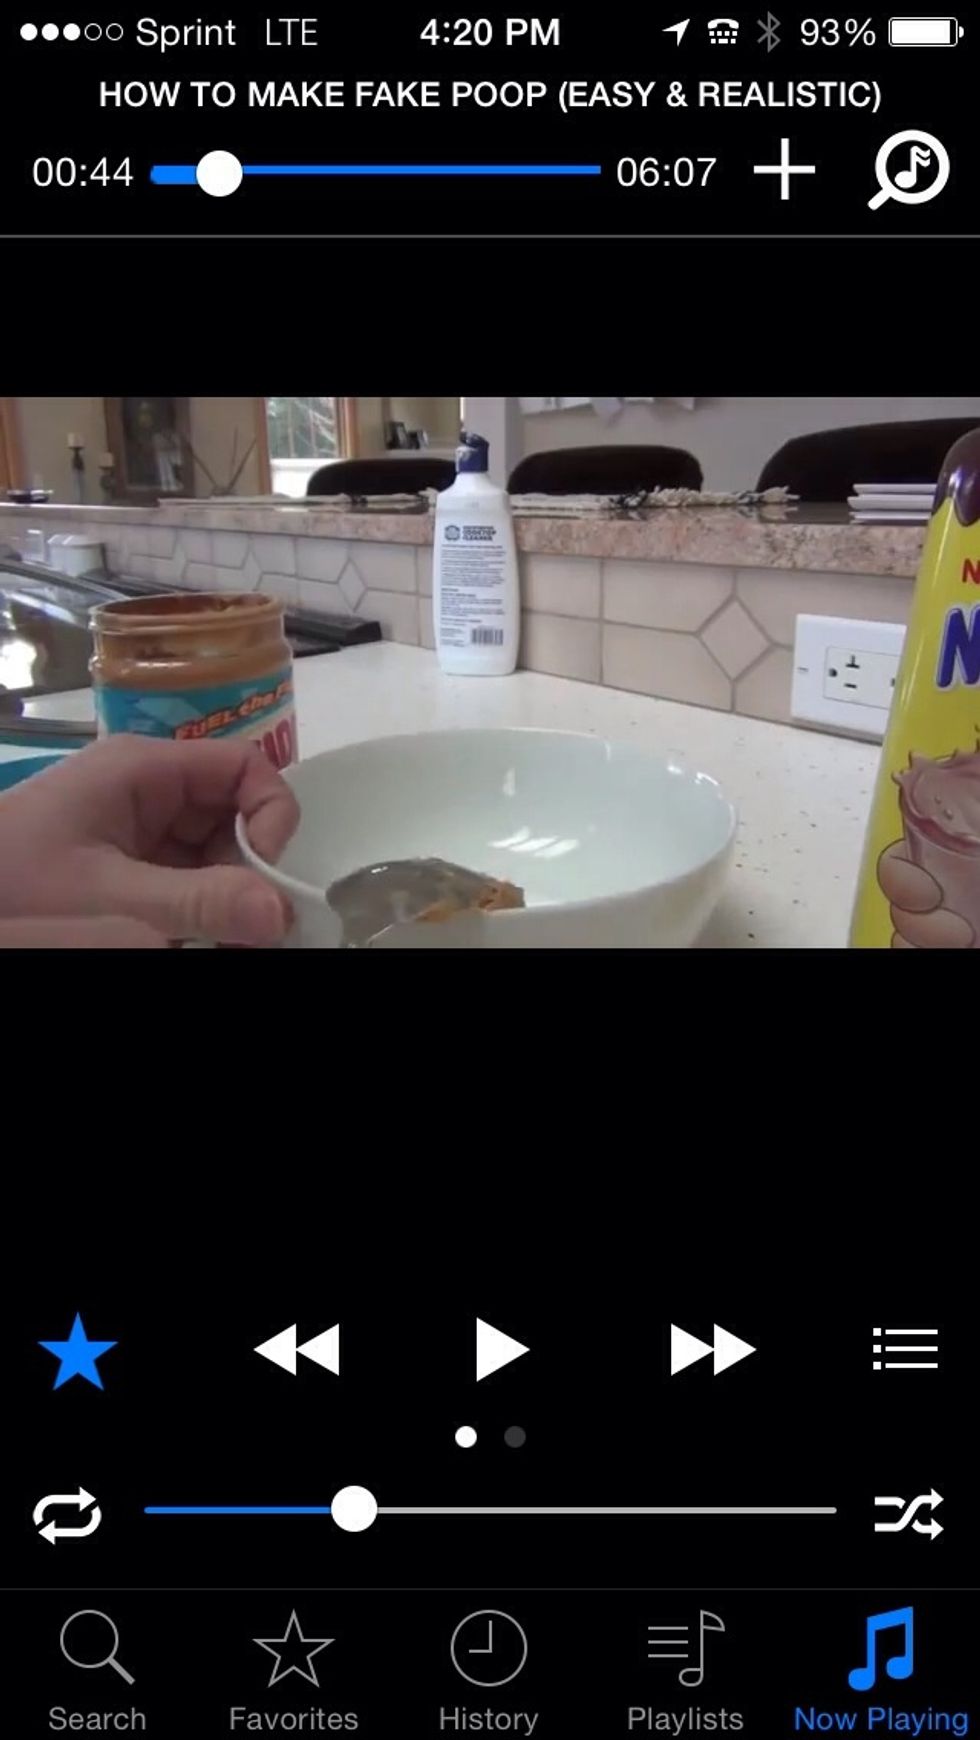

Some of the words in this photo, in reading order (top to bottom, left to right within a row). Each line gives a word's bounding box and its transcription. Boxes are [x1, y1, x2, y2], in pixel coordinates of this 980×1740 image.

[136, 17, 236, 53] Sprint
[267, 18, 318, 45] LTE
[420, 18, 492, 46] 4:20
[506, 18, 560, 46] PM
[801, 18, 876, 47] 93%
[100, 81, 181, 107] HOW
[190, 81, 236, 107] TO
[249, 81, 344, 107] MAKE
[356, 81, 440, 107] FAKE
[452, 81, 547, 107] POOP
[559, 81, 656, 113] (EASY
[666, 81, 688, 107] &
[699, 81, 881, 113] REALISTIC)
[33, 157, 134, 187] 00:44
[617, 157, 716, 187] 06:07
[49, 1707, 145, 1730] Search
[231, 1707, 358, 1730] Favorites
[440, 1707, 538, 1736] History
[629, 1707, 743, 1736] Playlists
[795, 1707, 857, 1731] Now
[868, 1707, 969, 1737] Playing
